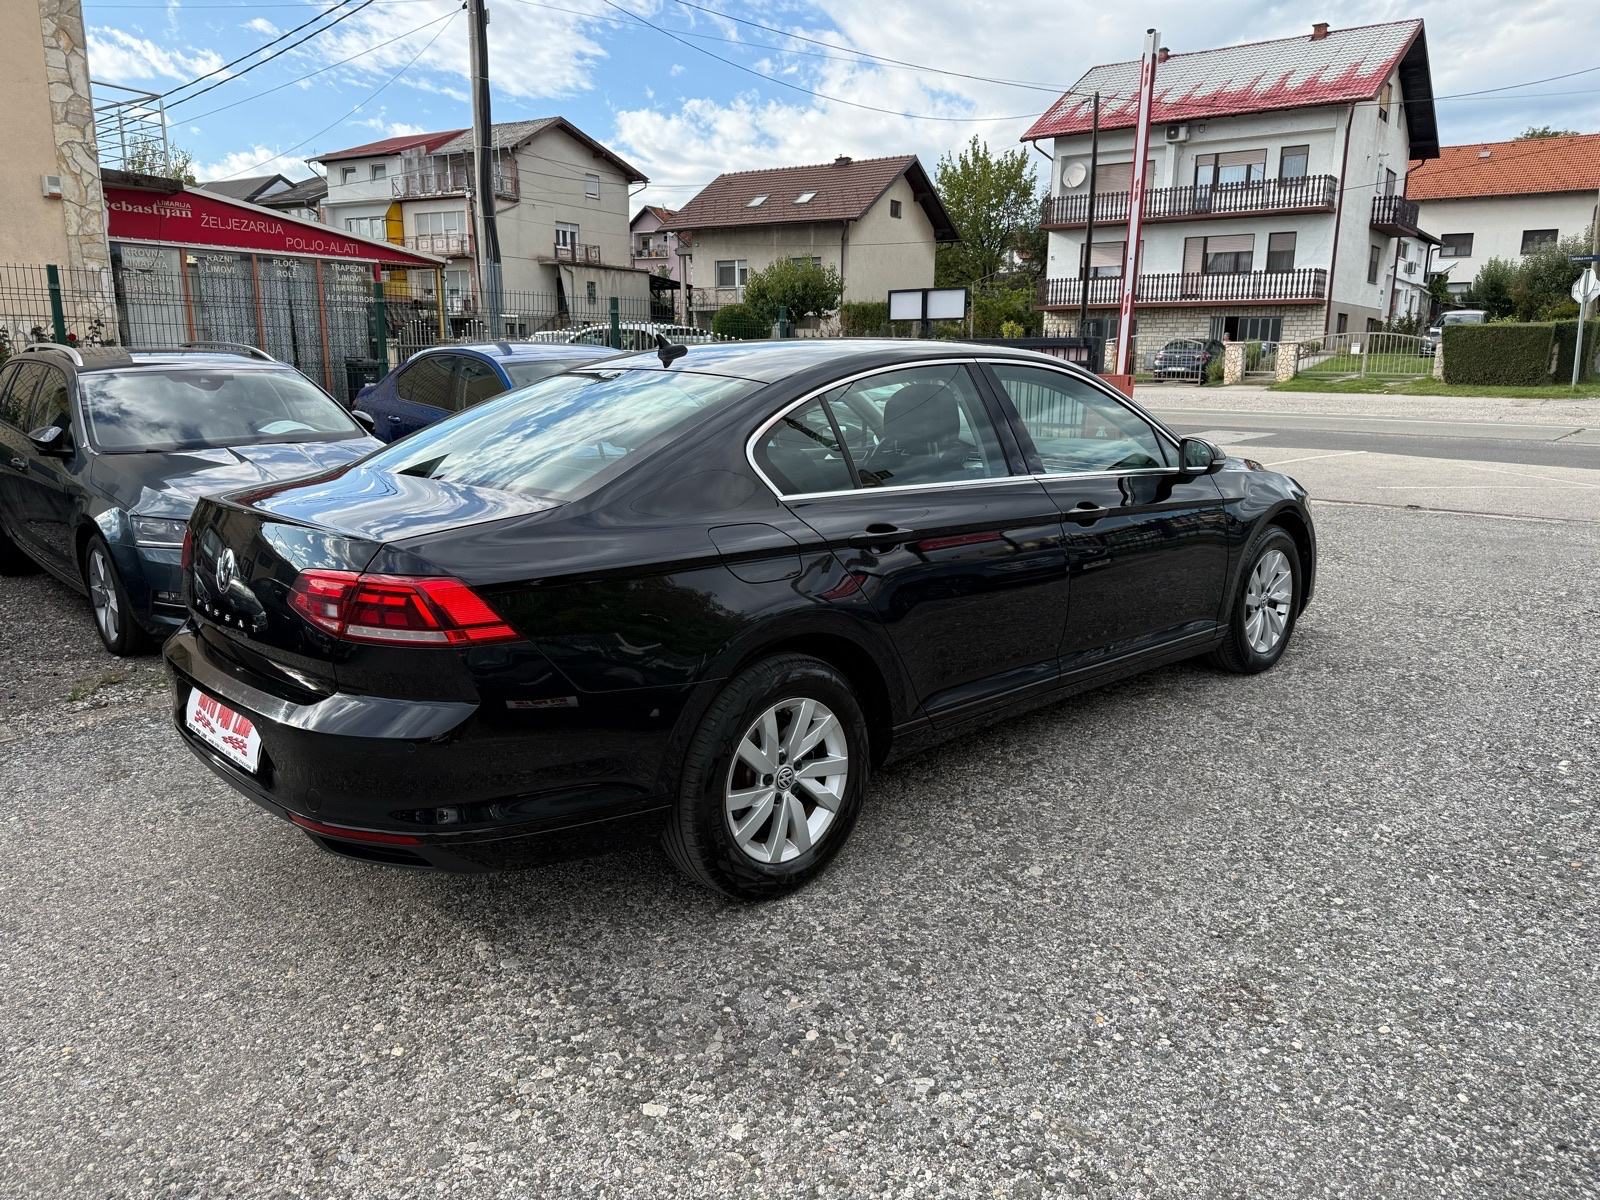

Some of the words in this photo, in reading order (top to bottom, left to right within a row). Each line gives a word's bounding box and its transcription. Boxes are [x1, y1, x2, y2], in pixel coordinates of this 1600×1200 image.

[157, 199, 191, 209] LIMARIJA
[200, 213, 285, 235] ŽELJEZARIJA
[285, 237, 359, 255] POLJO-ALATI
[330, 263, 366, 273] TRAPEZNI
